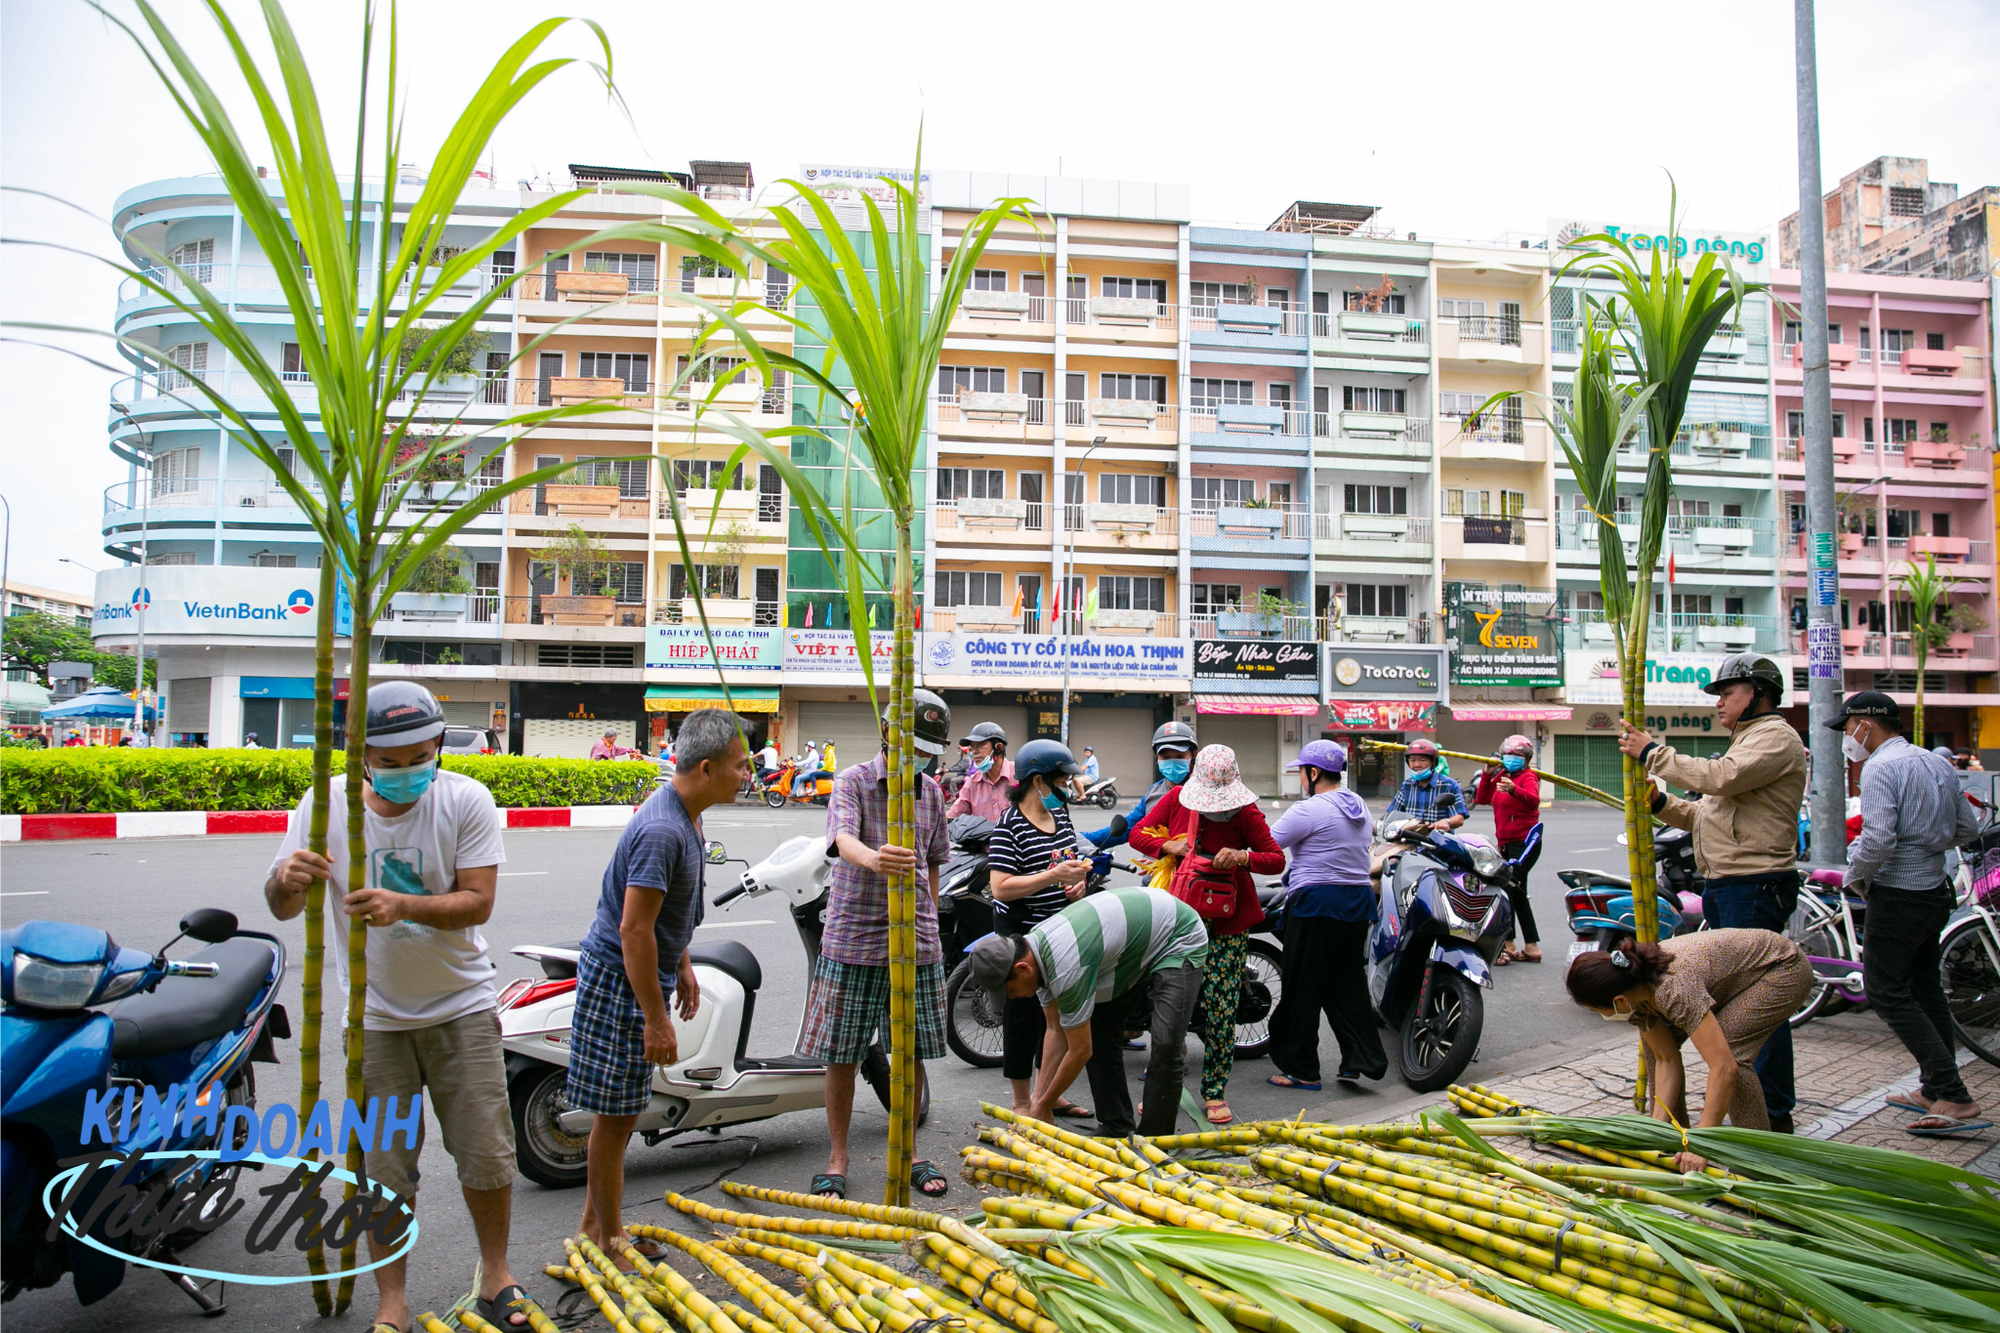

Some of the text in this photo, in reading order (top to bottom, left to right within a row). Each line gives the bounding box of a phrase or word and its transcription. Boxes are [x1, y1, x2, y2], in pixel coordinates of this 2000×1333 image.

[1605, 225, 1764, 264] Trang nông
[1475, 590, 1503, 604] THỰC
[1504, 592, 1557, 603] HONGKONG
[184, 602, 288, 620] VietinBank
[660, 629, 677, 638] ĐẠI
[679, 628, 690, 636] LÝ
[725, 629, 744, 638] CÁC
[748, 629, 770, 638] TỈNH
[817, 632, 827, 640] TÁC
[1474, 608, 1503, 648] 7
[965, 637, 1184, 661] CÔNG TY CỔ PHẦN HOA THỊNH
[1494, 635, 1538, 648] SEVEN
[668, 640, 760, 662] HIỆP PHÁT
[794, 642, 839, 658] VIỆT
[1198, 642, 1314, 665] Bếp Nhà Gấu
[971, 659, 993, 667] CHUYÊN
[994, 660, 1008, 668] KINH
[1080, 661, 1088, 669] VÀ
[1112, 662, 1124, 671] LIỆU
[1125, 662, 1139, 670] THỨC
[1481, 655, 1493, 665] VỤ
[1494, 652, 1515, 663] ĐIỂM
[1516, 654, 1534, 664] TÂM
[1535, 654, 1558, 664] SÁNG
[1473, 666, 1493, 675] MÓN
[1494, 666, 1512, 675] XÀO
[1513, 667, 1558, 675] HONGKONG
[1645, 660, 1711, 690] Trang
[1037, 726, 1048, 734] 2M
[1671, 712, 1712, 732] nông
